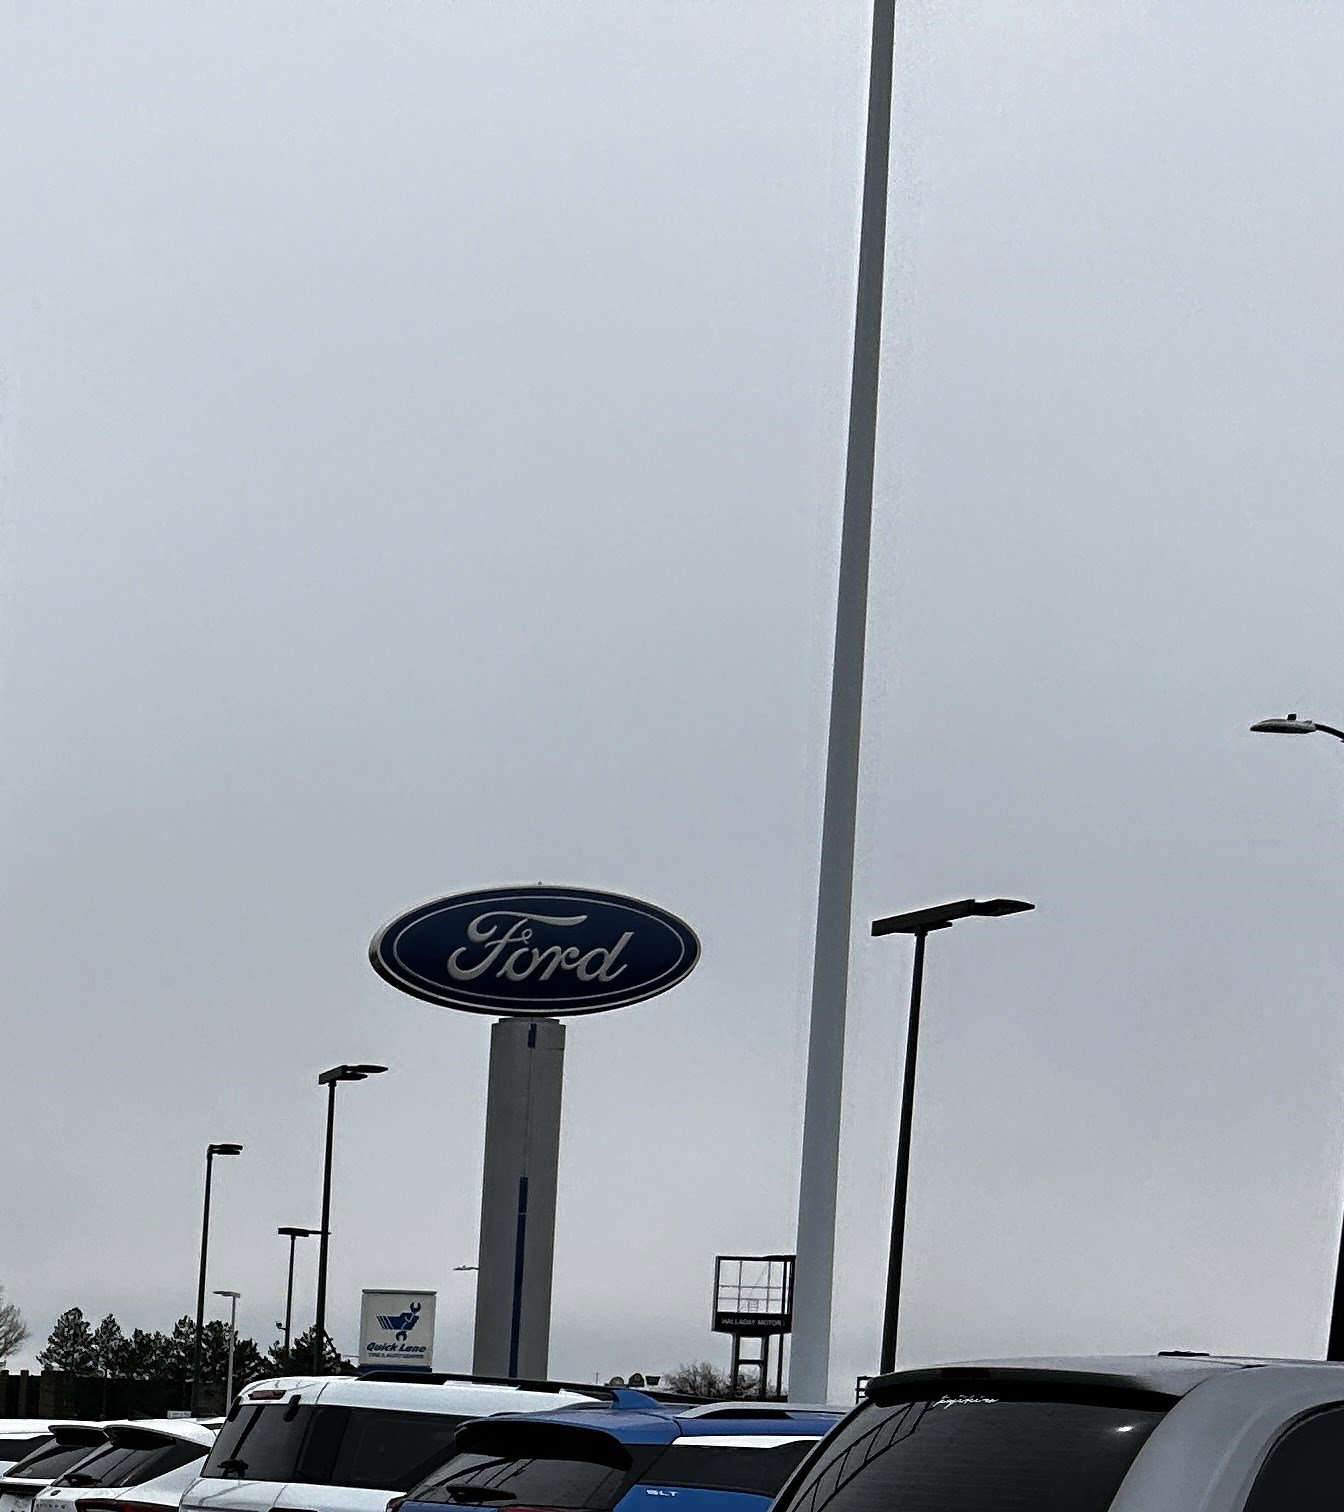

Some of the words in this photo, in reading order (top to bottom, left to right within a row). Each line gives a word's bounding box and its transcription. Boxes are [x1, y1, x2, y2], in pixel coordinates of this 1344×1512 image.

[447, 910, 635, 982] Ford
[366, 1342, 398, 1352] Quick
[399, 1343, 427, 1353] Lane
